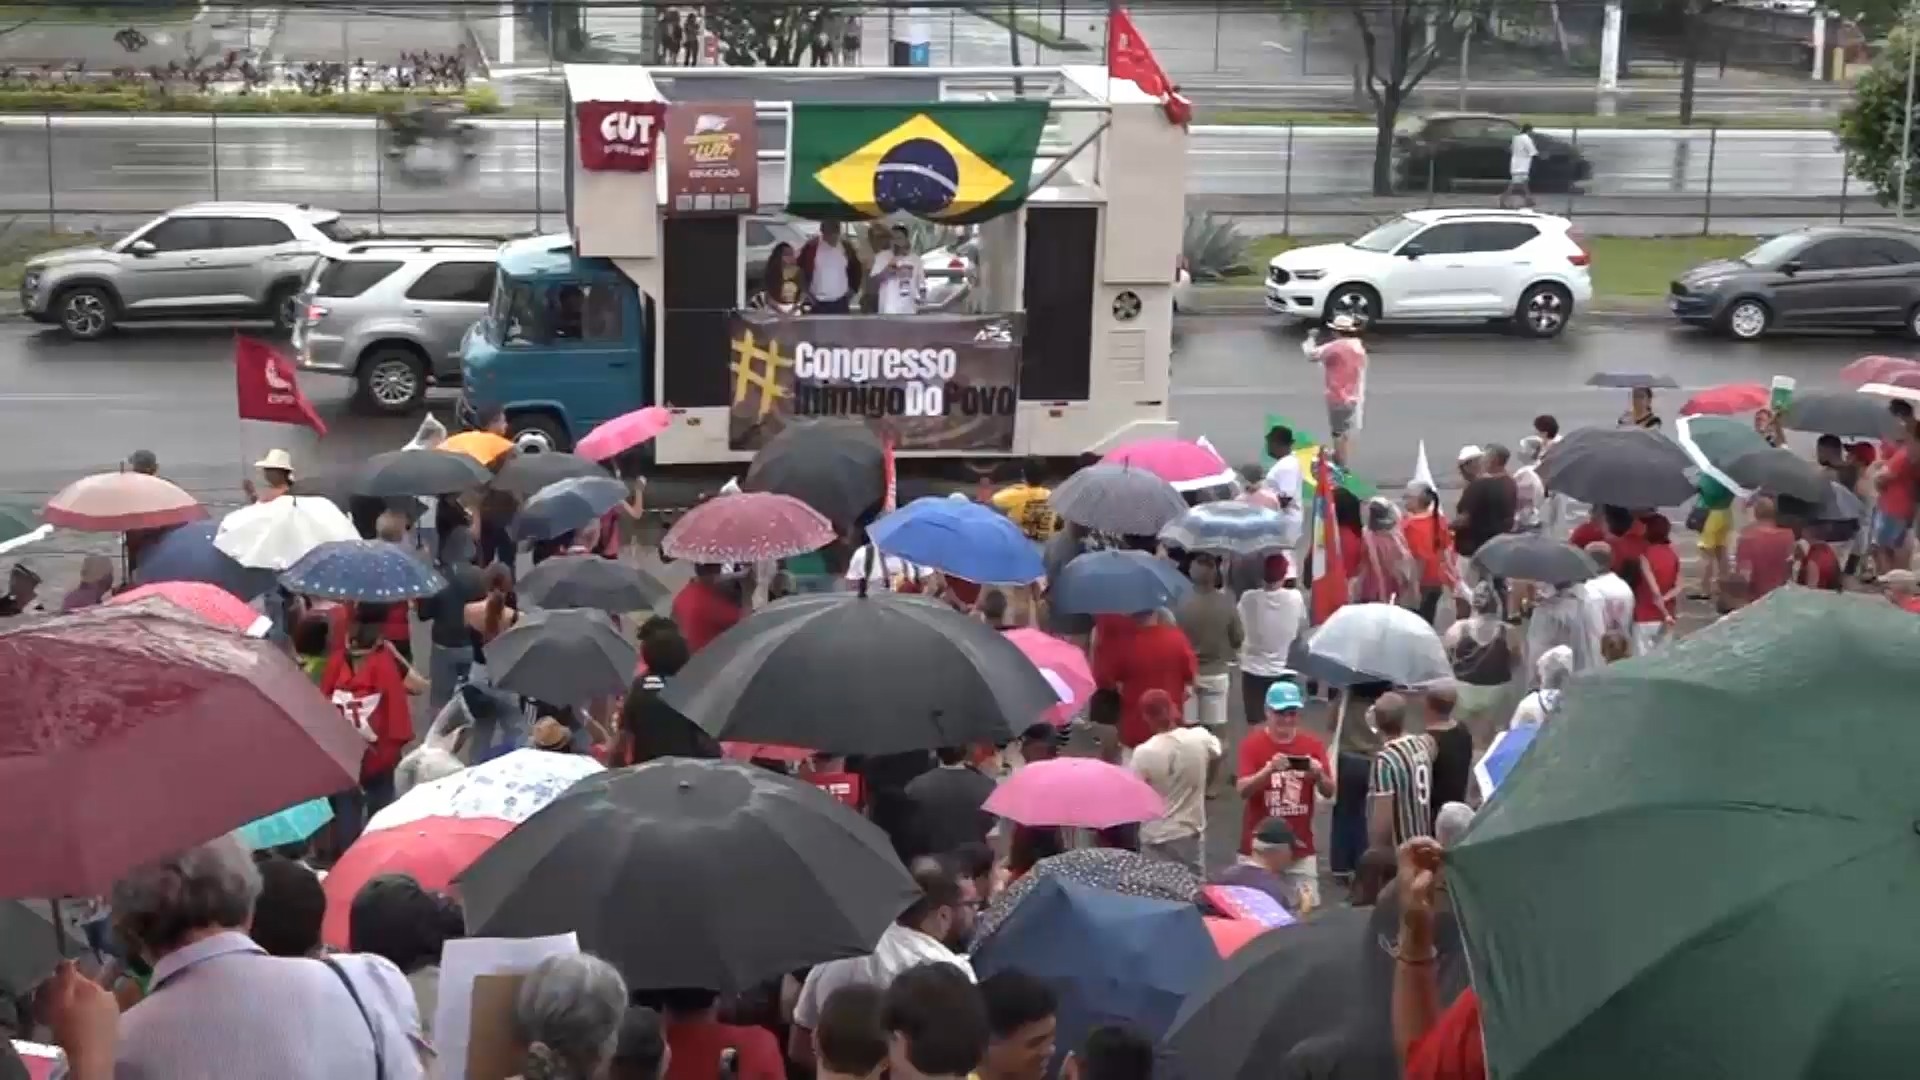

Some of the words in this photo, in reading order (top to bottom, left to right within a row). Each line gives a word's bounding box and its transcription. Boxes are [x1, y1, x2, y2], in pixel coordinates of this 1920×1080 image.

[601, 112, 655, 144] CUT
[795, 342, 957, 382] Congresso
[1415, 764, 1430, 805] 9
